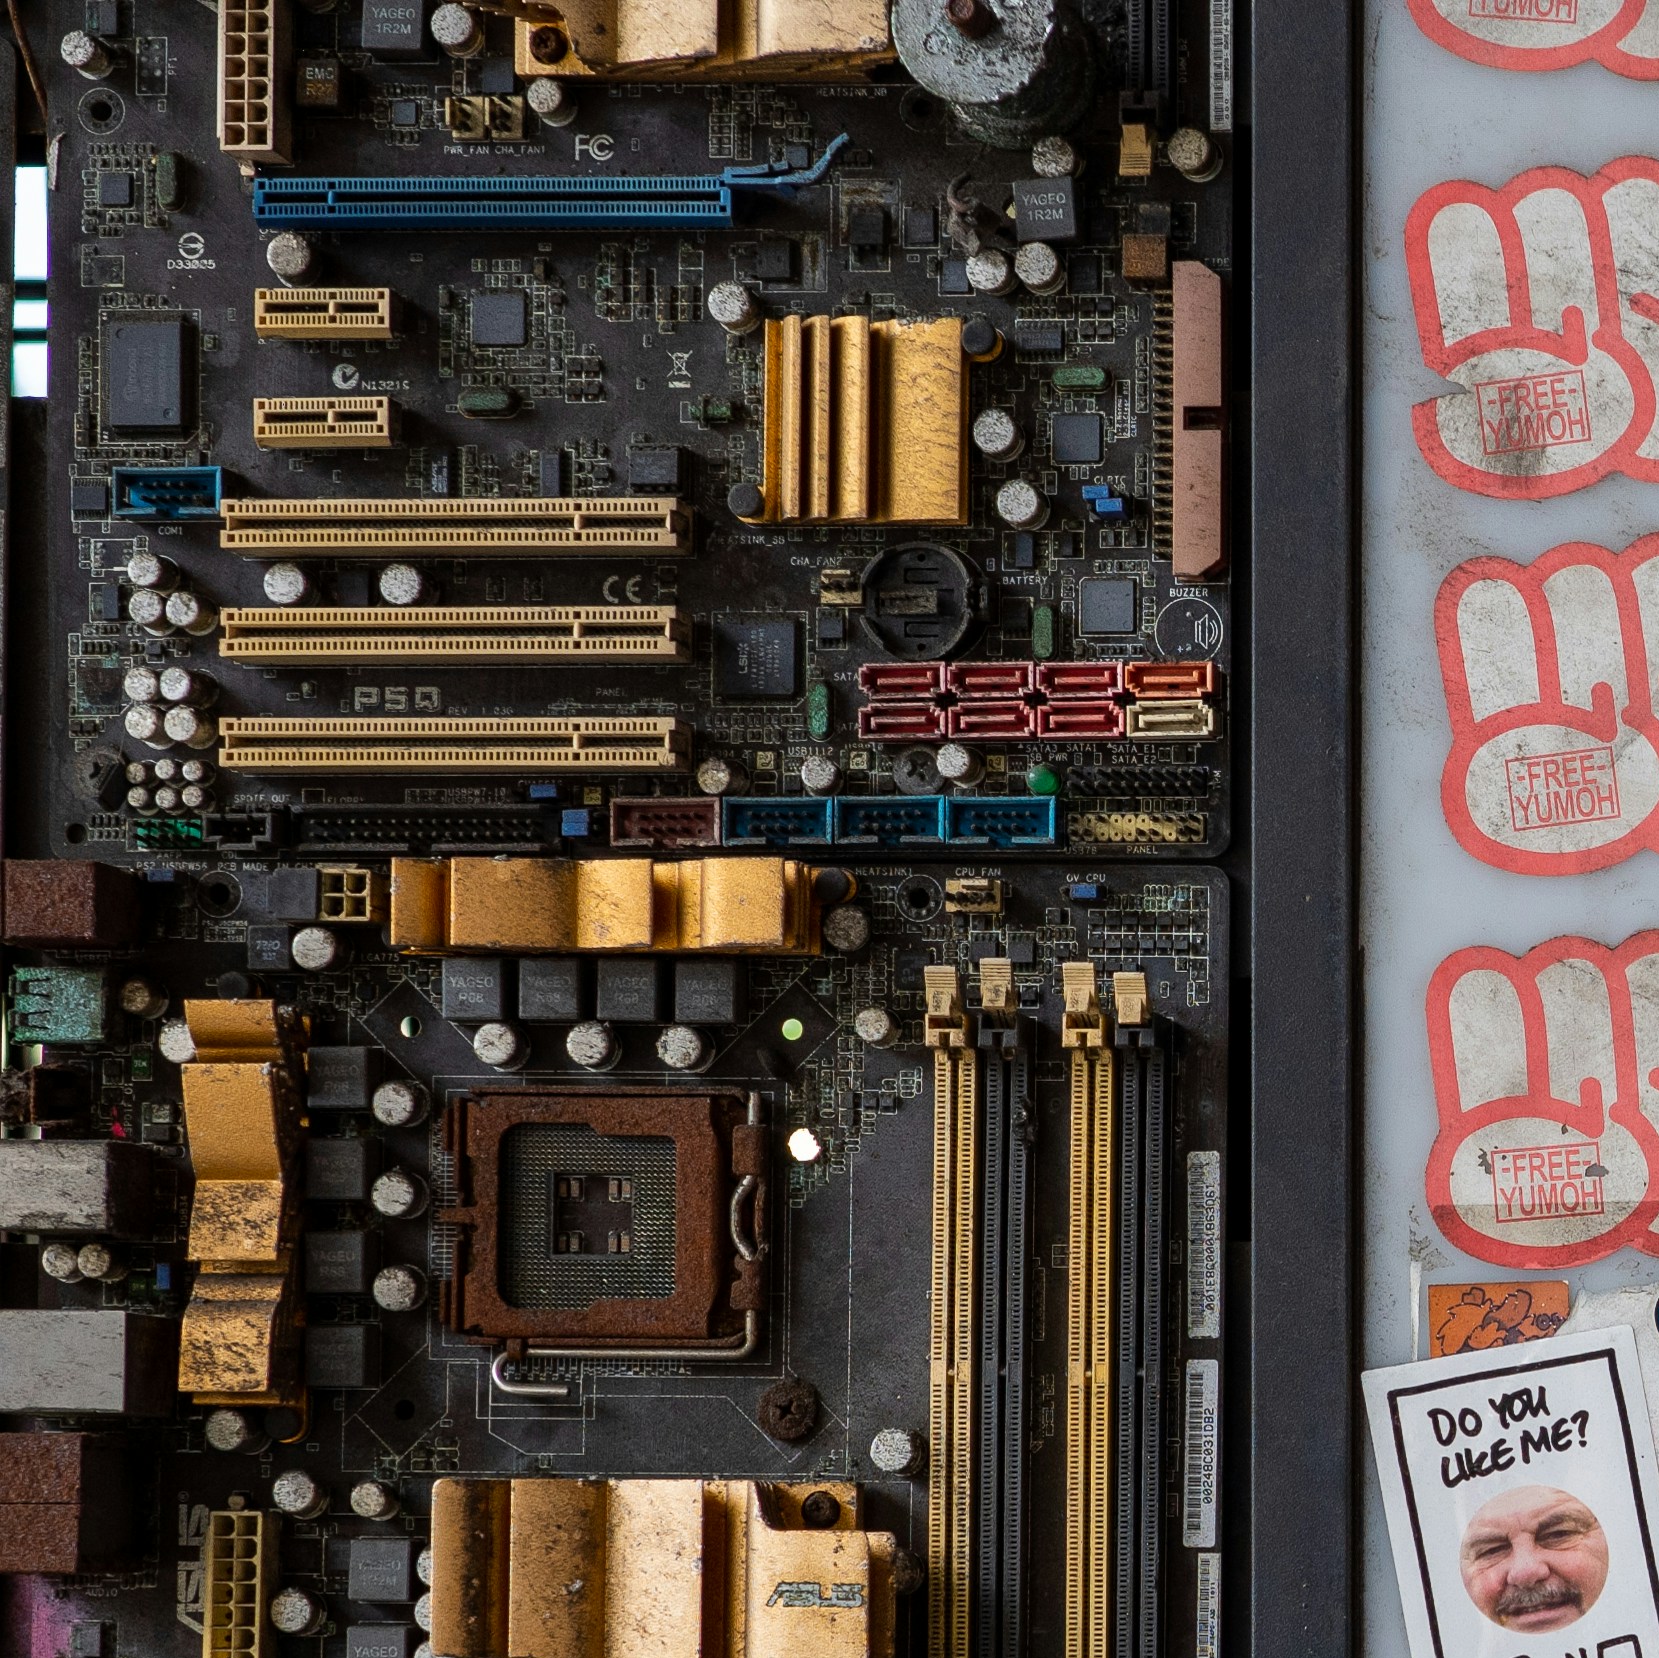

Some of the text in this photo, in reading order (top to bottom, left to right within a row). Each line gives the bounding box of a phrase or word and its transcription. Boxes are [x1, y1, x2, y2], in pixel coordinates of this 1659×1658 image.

[372, 7, 416, 19] YAGEO
[375, 23, 411, 34] 1R2M
[443, 145, 490, 157] PWR_FAN
[1021, 192, 1066, 206] YAGEO
[1027, 208, 1064, 221] 1R2M
[1487, 409, 1586, 452] YUMOH
[158, 526, 184, 536] COM1
[1002, 576, 1048, 586] BATTERY
[1169, 587, 1209, 598] BUZZER
[1025, 744, 1058, 754] SATA3
[1066, 744, 1098, 754] SATA1
[1517, 753, 1608, 790] -FREE-
[1514, 783, 1618, 825] YUMOH
[1126, 845, 1159, 855] PANEL
[242, 861, 269, 872] MADE
[855, 867, 913, 878] HEATSINK1
[955, 867, 1001, 879] CPU_FAN
[1086, 873, 1106, 883] CPU
[448, 976, 493, 988] YAGEO
[1499, 1177, 1601, 1219] YUMOH
[1427, 1384, 1552, 1447] DO YOU
[1202, 1407, 1214, 1504] 00248C031DB2
[1440, 1412, 1591, 1489] LIKE ME?
[765, 1581, 865, 1608] ASUS
[353, 1646, 398, 1658] YAGEO
